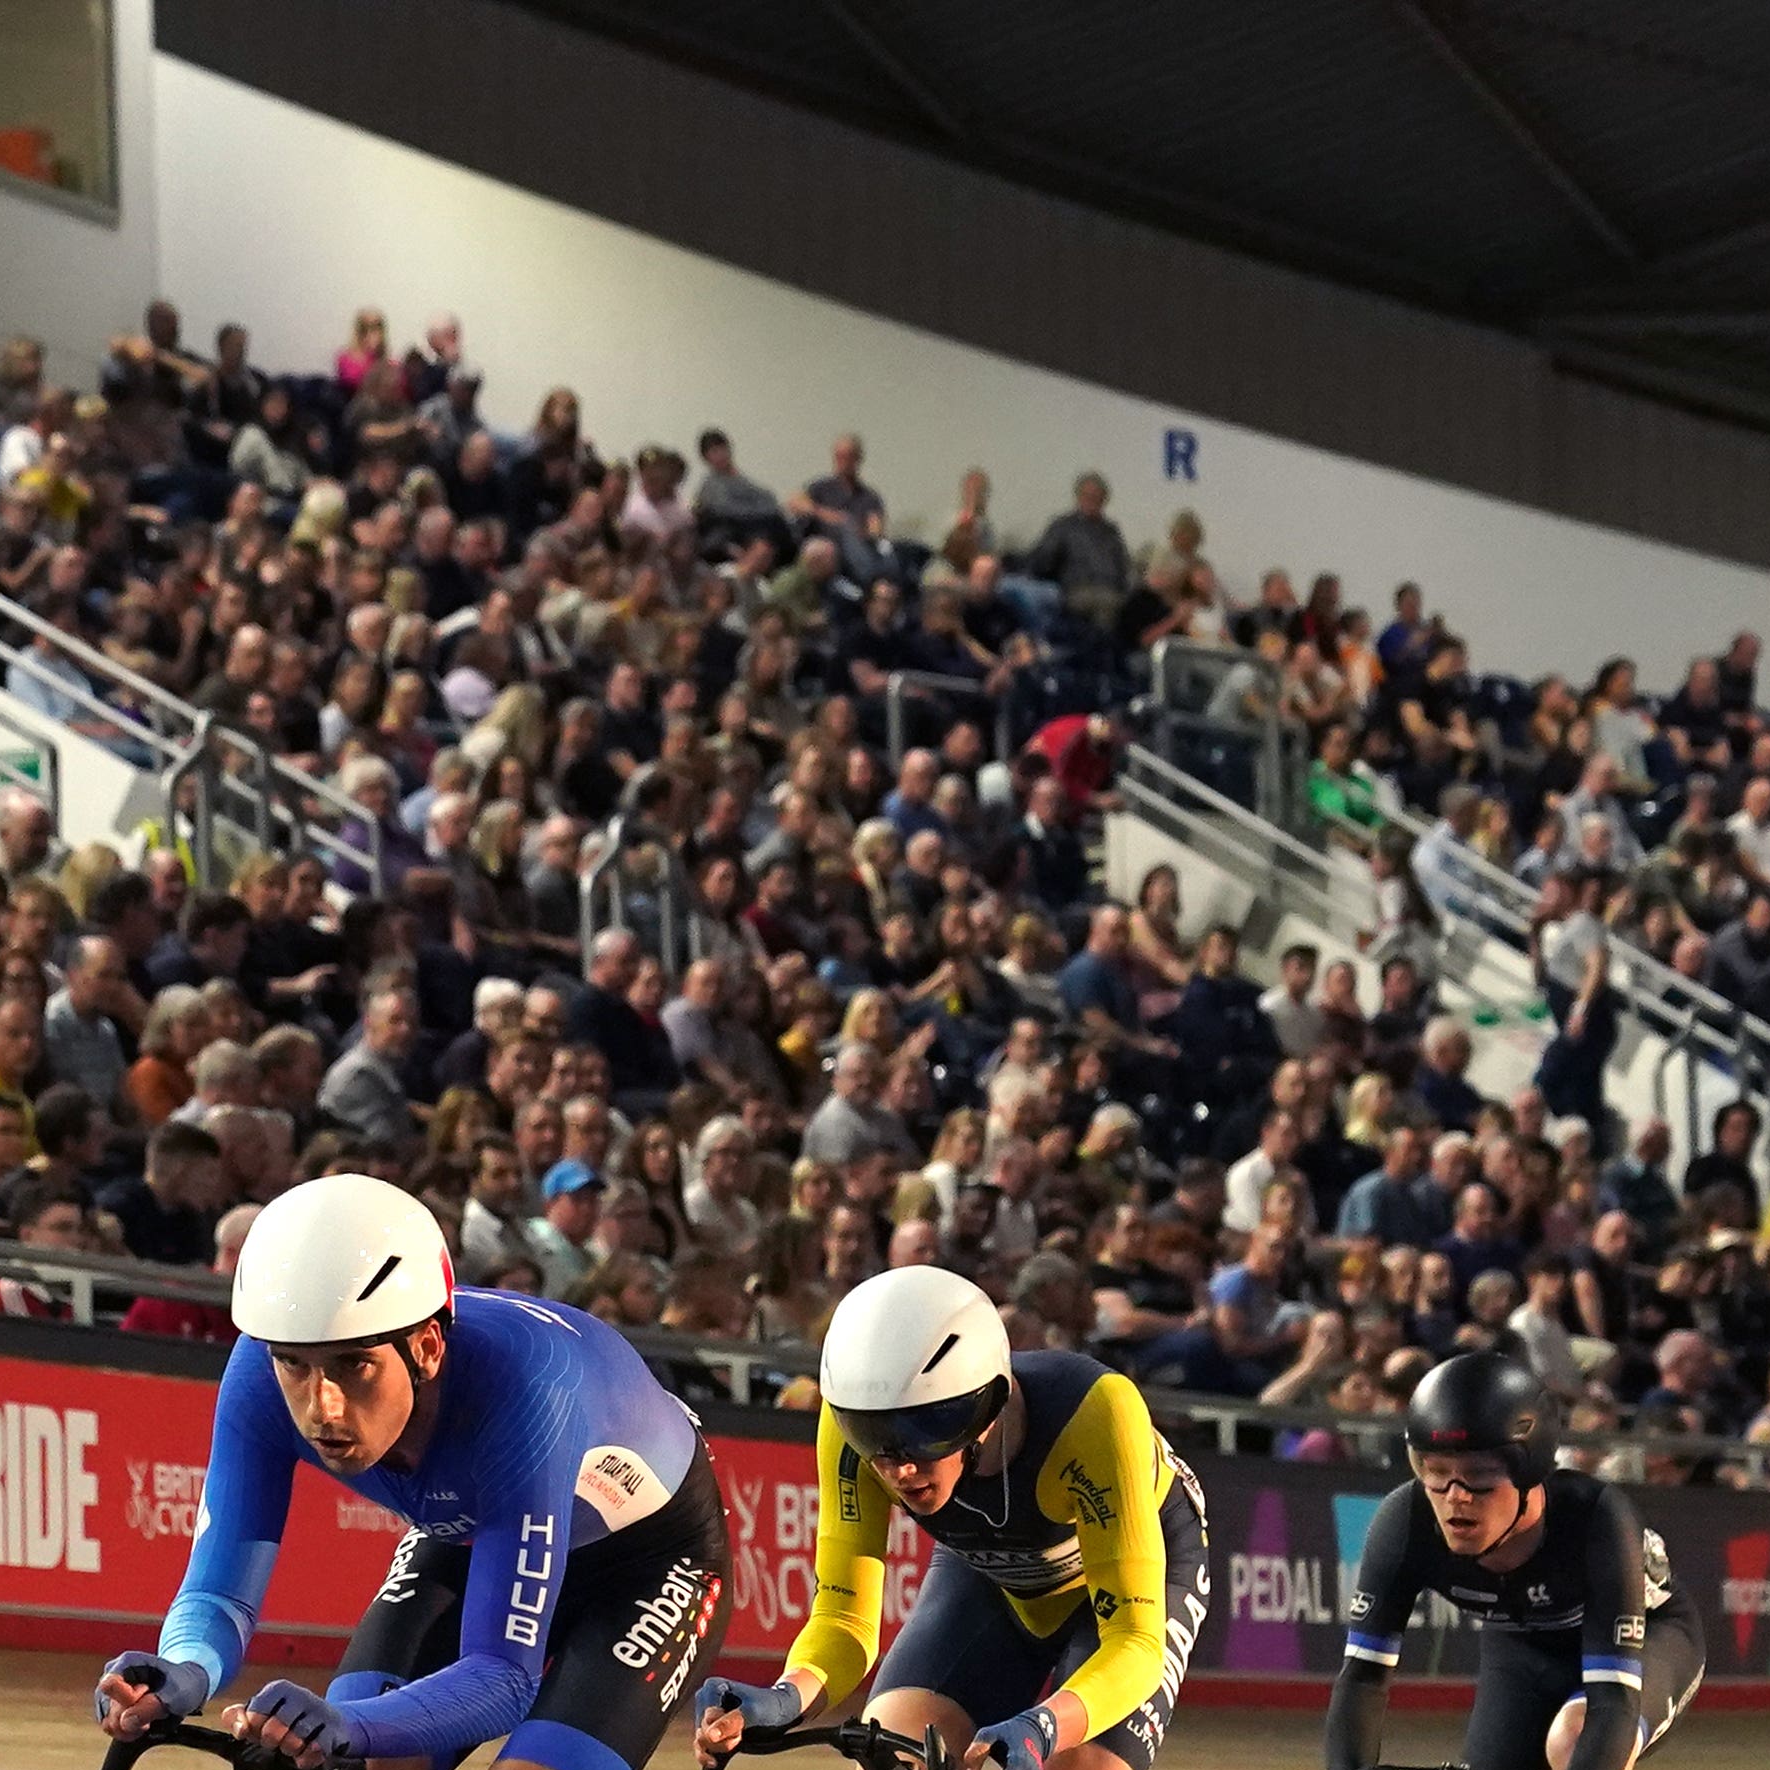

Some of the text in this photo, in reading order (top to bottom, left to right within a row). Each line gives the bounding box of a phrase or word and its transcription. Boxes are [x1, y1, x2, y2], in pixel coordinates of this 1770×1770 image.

[1164, 428, 1198, 480] R
[505, 1513, 554, 1648] HUUB
[612, 1560, 704, 1669] embark
[1231, 1552, 1332, 1624] PEDAL
